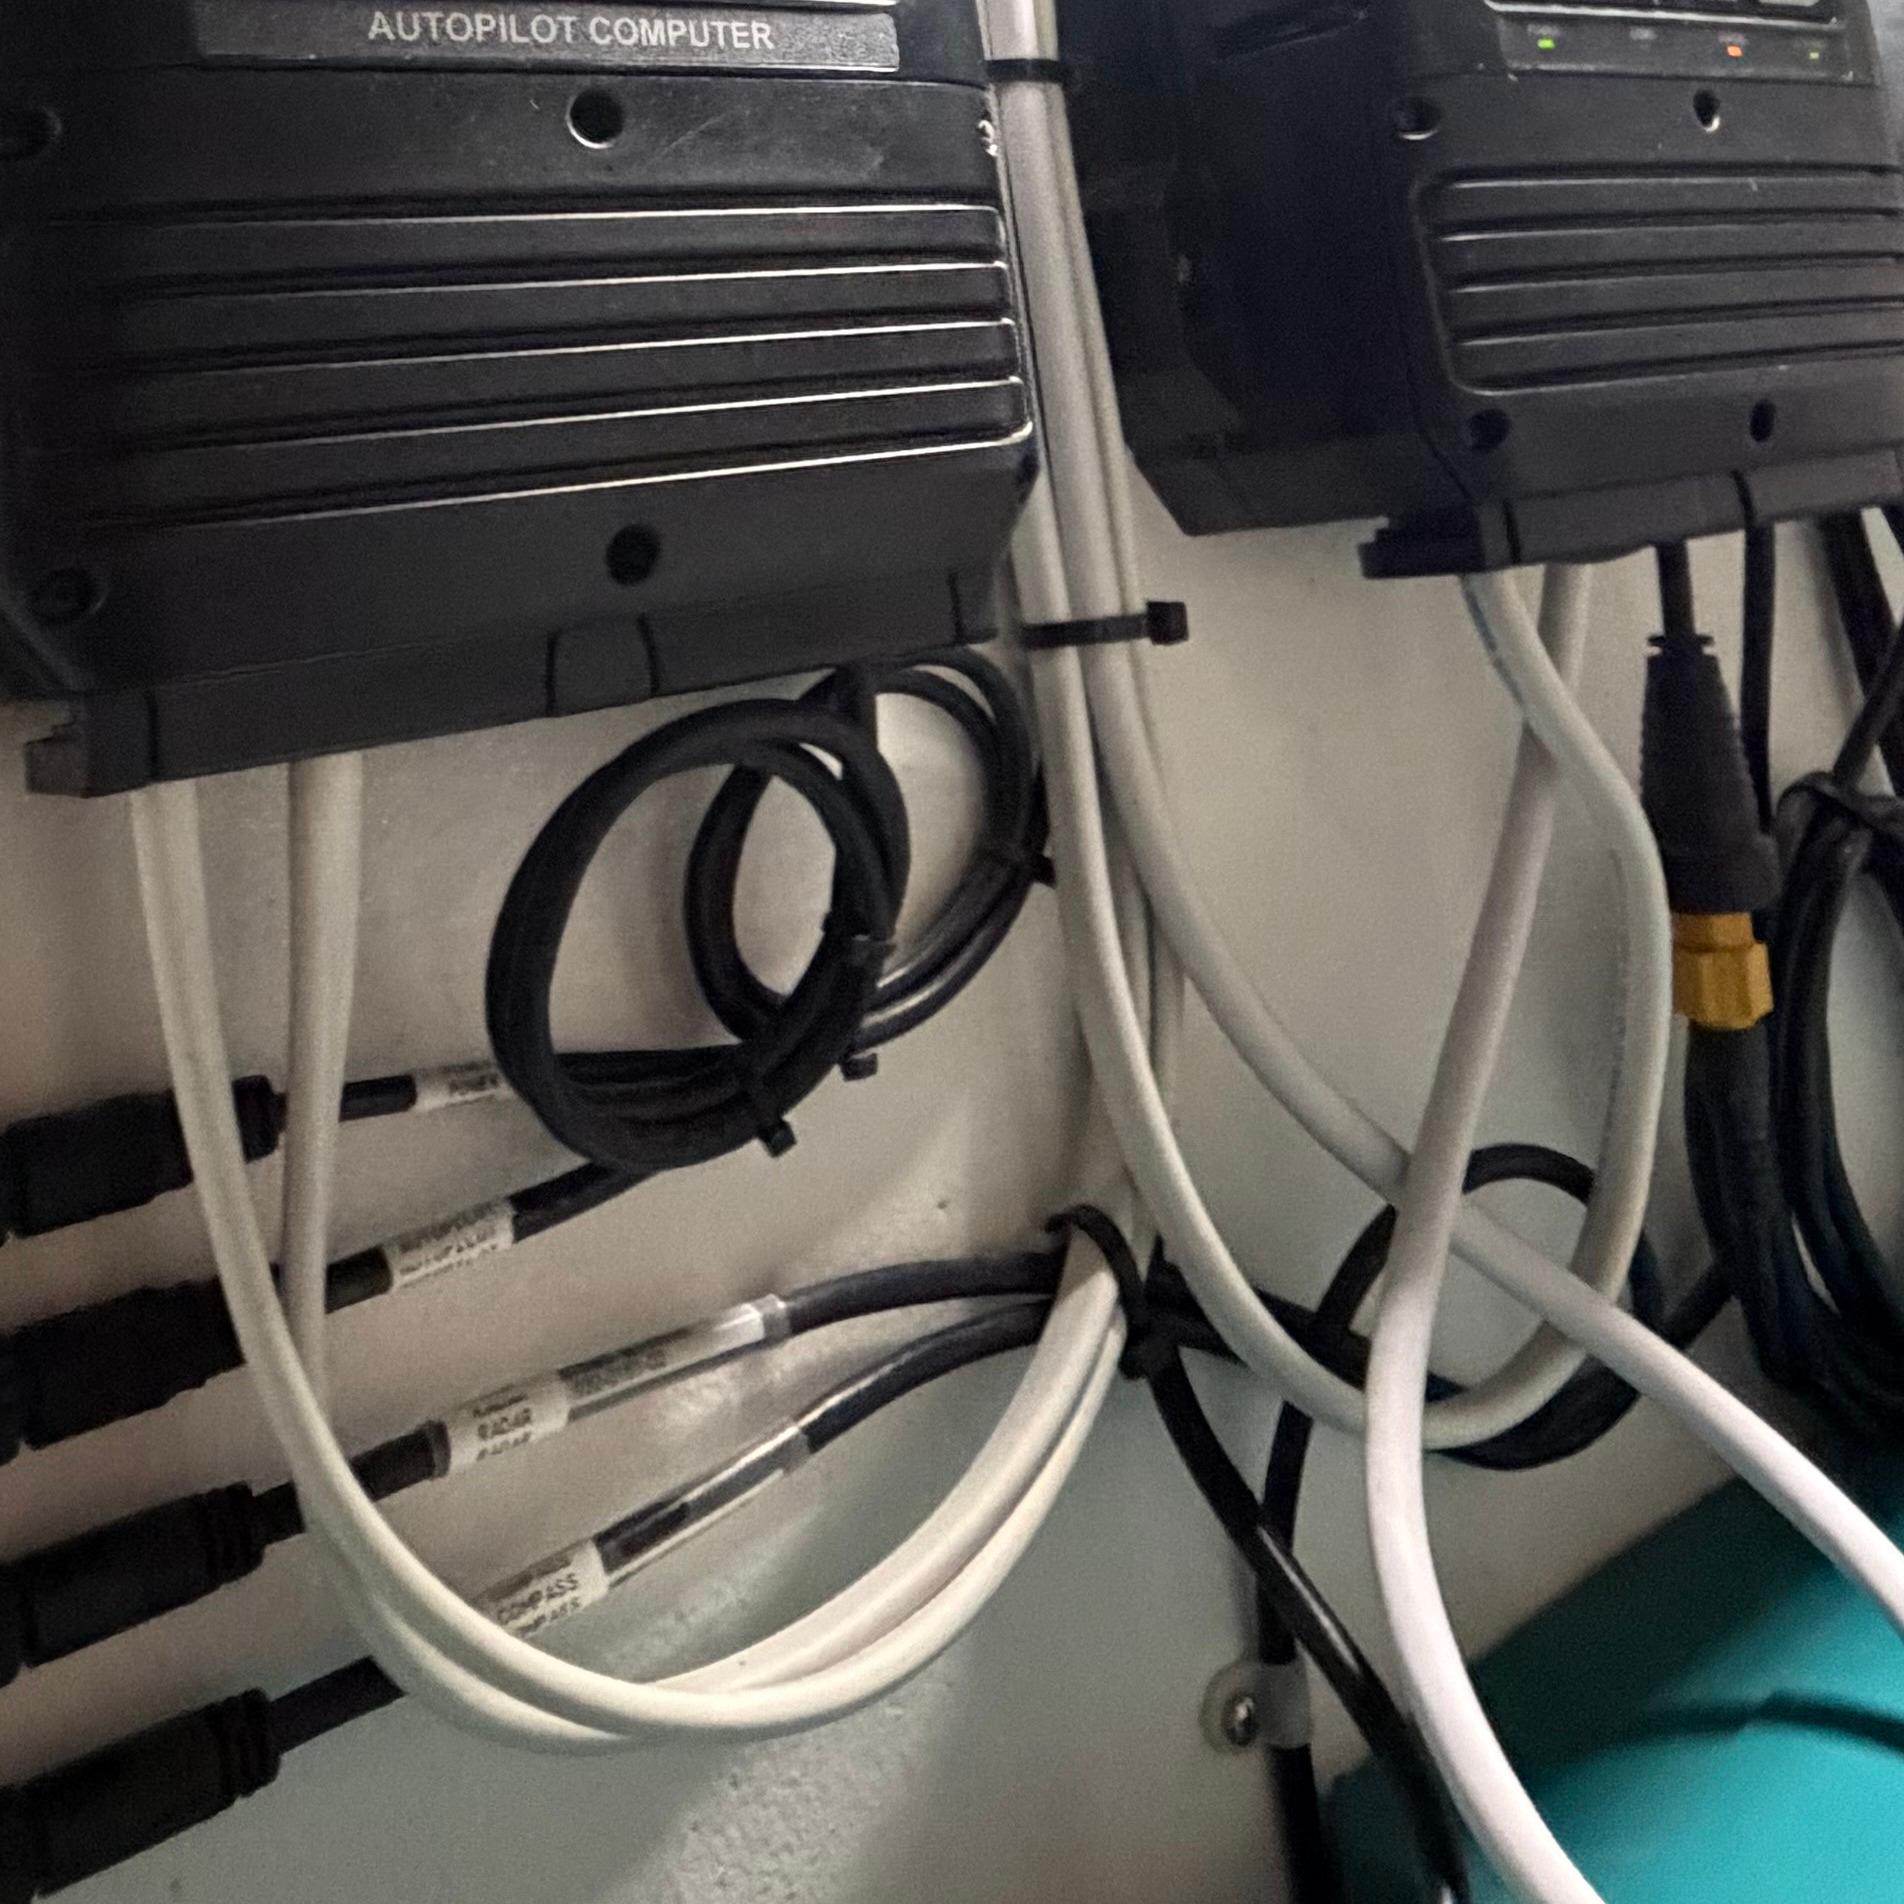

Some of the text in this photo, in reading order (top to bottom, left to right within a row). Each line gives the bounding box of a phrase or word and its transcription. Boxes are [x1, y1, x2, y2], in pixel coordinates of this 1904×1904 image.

[367, 10, 776, 51] AUTOPILOT COMPUTER
[496, 1572, 579, 1627] COMPASS
